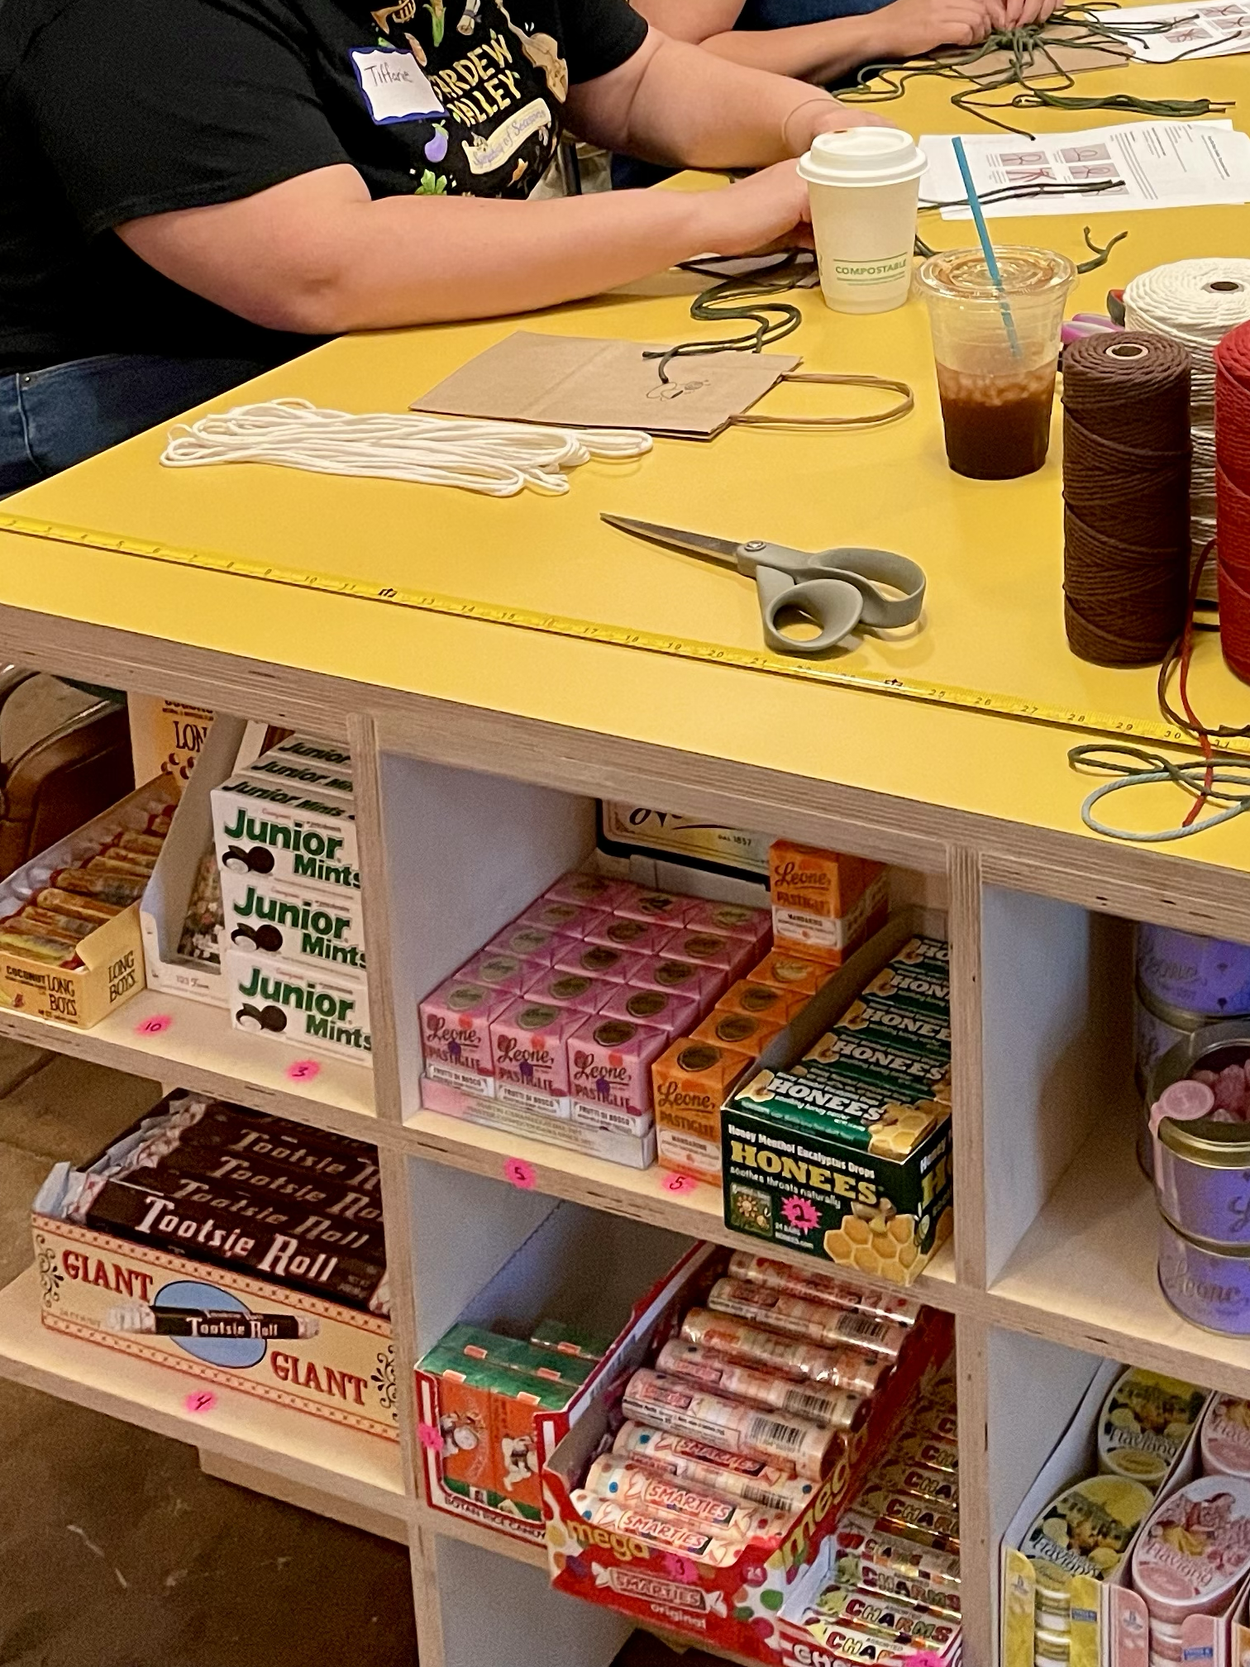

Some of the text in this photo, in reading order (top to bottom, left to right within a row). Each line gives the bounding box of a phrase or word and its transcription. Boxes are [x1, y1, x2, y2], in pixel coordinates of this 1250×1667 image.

[835, 258, 907, 275] COMPOSTABLE
[707, 649, 725, 658] 20
[928, 689, 946, 699] 25
[974, 696, 992, 706] 26
[1020, 704, 1039, 714] 27
[1067, 713, 1086, 723] 28
[1115, 721, 1134, 731] 29
[1163, 730, 1182, 740] 30
[250, 761, 329, 783] Junior
[221, 780, 347, 817] Junior Mints
[223, 808, 344, 861] Junior
[293, 853, 361, 889] Mints
[233, 885, 350, 940] Junior
[107, 949, 135, 984] LONG
[301, 932, 367, 969] Mints
[6, 965, 76, 998] COCONUT LONG
[109, 968, 136, 1004] BOYS
[237, 967, 354, 1021] Junior
[48, 993, 78, 1017] BOYS
[305, 1014, 372, 1052] Mints
[432, 1067, 453, 1080] FRUTTI
[831, 1039, 947, 1081] HONEES
[503, 1087, 525, 1101] FRUTTI
[579, 1104, 600, 1118] FRUTTI
[766, 1077, 886, 1121] HONEES
[227, 1128, 347, 1175] Tootsie
[728, 1123, 875, 1180] Honey Menthol Eucalyptus Drops
[206, 1155, 327, 1202] Tootsie
[668, 1175, 687, 1190] 5
[729, 1166, 842, 1210] soothes throats naturally
[730, 1139, 879, 1205] HONEES
[170, 1178, 370, 1250] Tootsie Roll
[135, 1194, 338, 1283] Tootsie Roll
[61, 1248, 155, 1303] GIANT
[185, 1316, 279, 1340] Tootsie Roll
[270, 1349, 368, 1408] GIANT
[678, 1437, 764, 1471] SMARTIES
[648, 1483, 732, 1521] SMARTIES
[565, 1518, 650, 1562] mega
[622, 1511, 711, 1548] SMARTIES
[613, 1572, 702, 1609] SMARTIES
[650, 1603, 708, 1630] original
[844, 1597, 954, 1642] CHARMS
